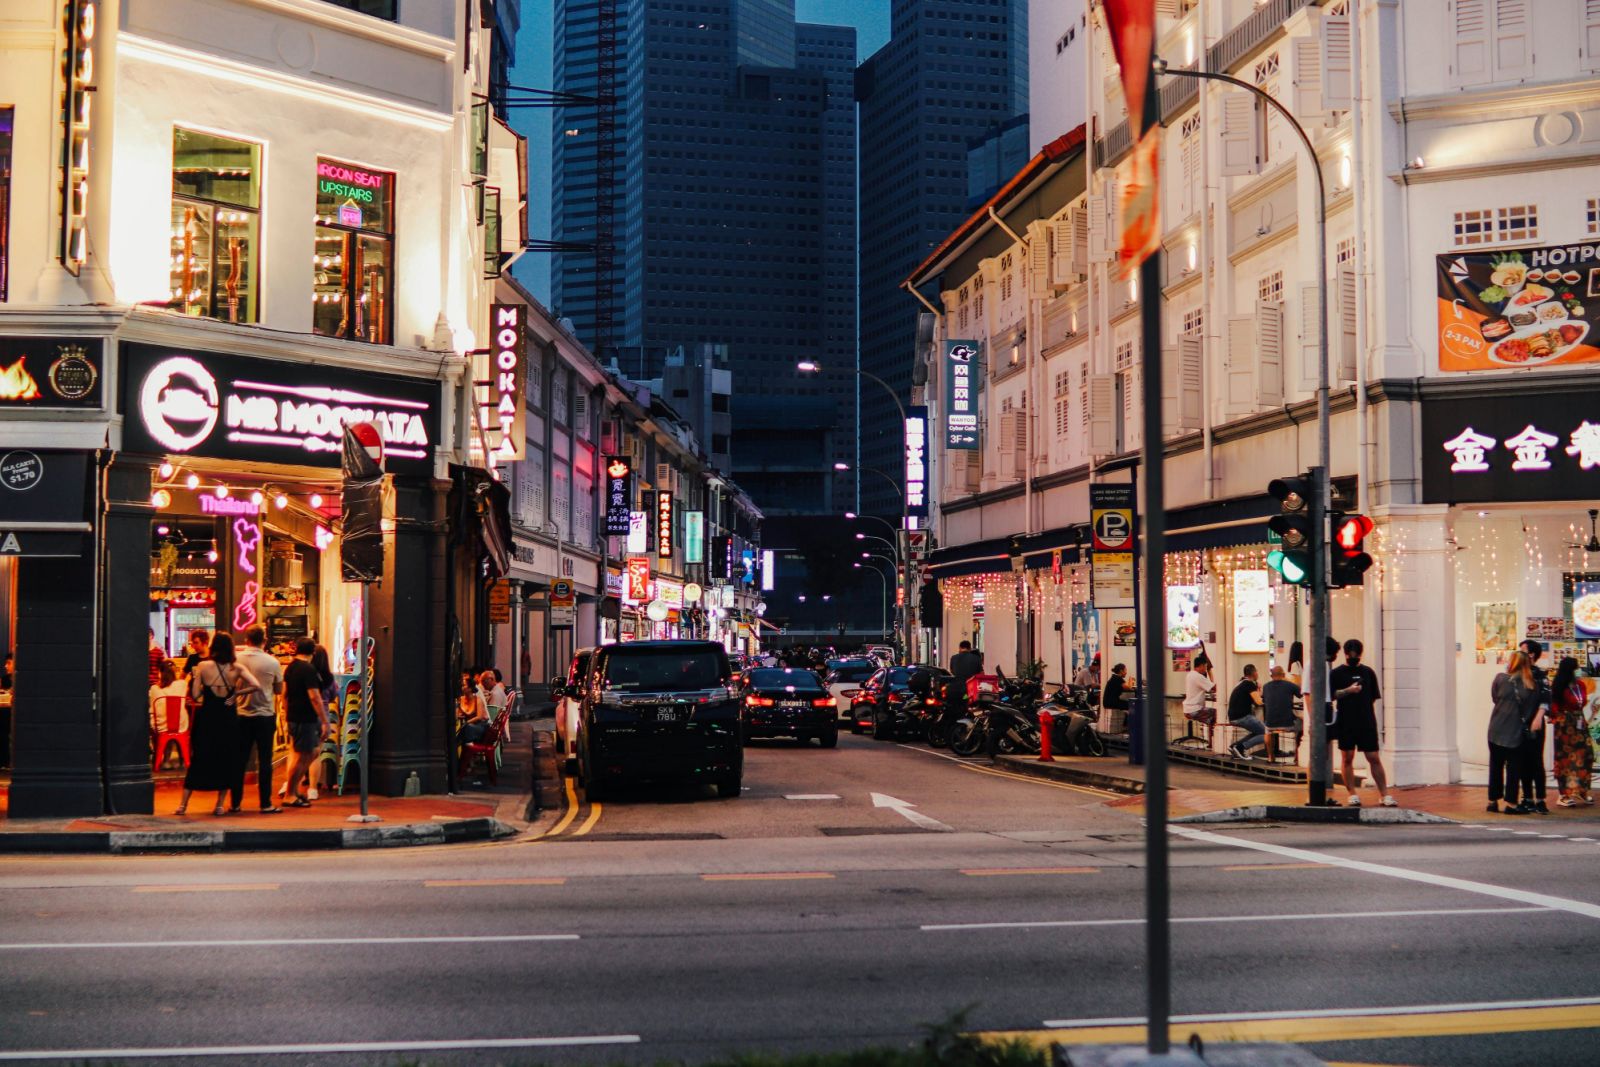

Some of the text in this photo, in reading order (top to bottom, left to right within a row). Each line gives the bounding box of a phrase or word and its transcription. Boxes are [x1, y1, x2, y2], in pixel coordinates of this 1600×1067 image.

[320, 180, 373, 202] UPSTAIRS
[354, 172, 383, 189] SEAT
[1531, 244, 1600, 267] HOTP
[1446, 329, 1482, 350] 2-3 PAX
[498, 307, 518, 456] MOOKATA
[226, 394, 278, 431] MR
[950, 434, 962, 444] 3F
[10, 471, 36, 483] $1.70
[1103, 514, 1126, 537] P
[630, 564, 646, 595] SPA
